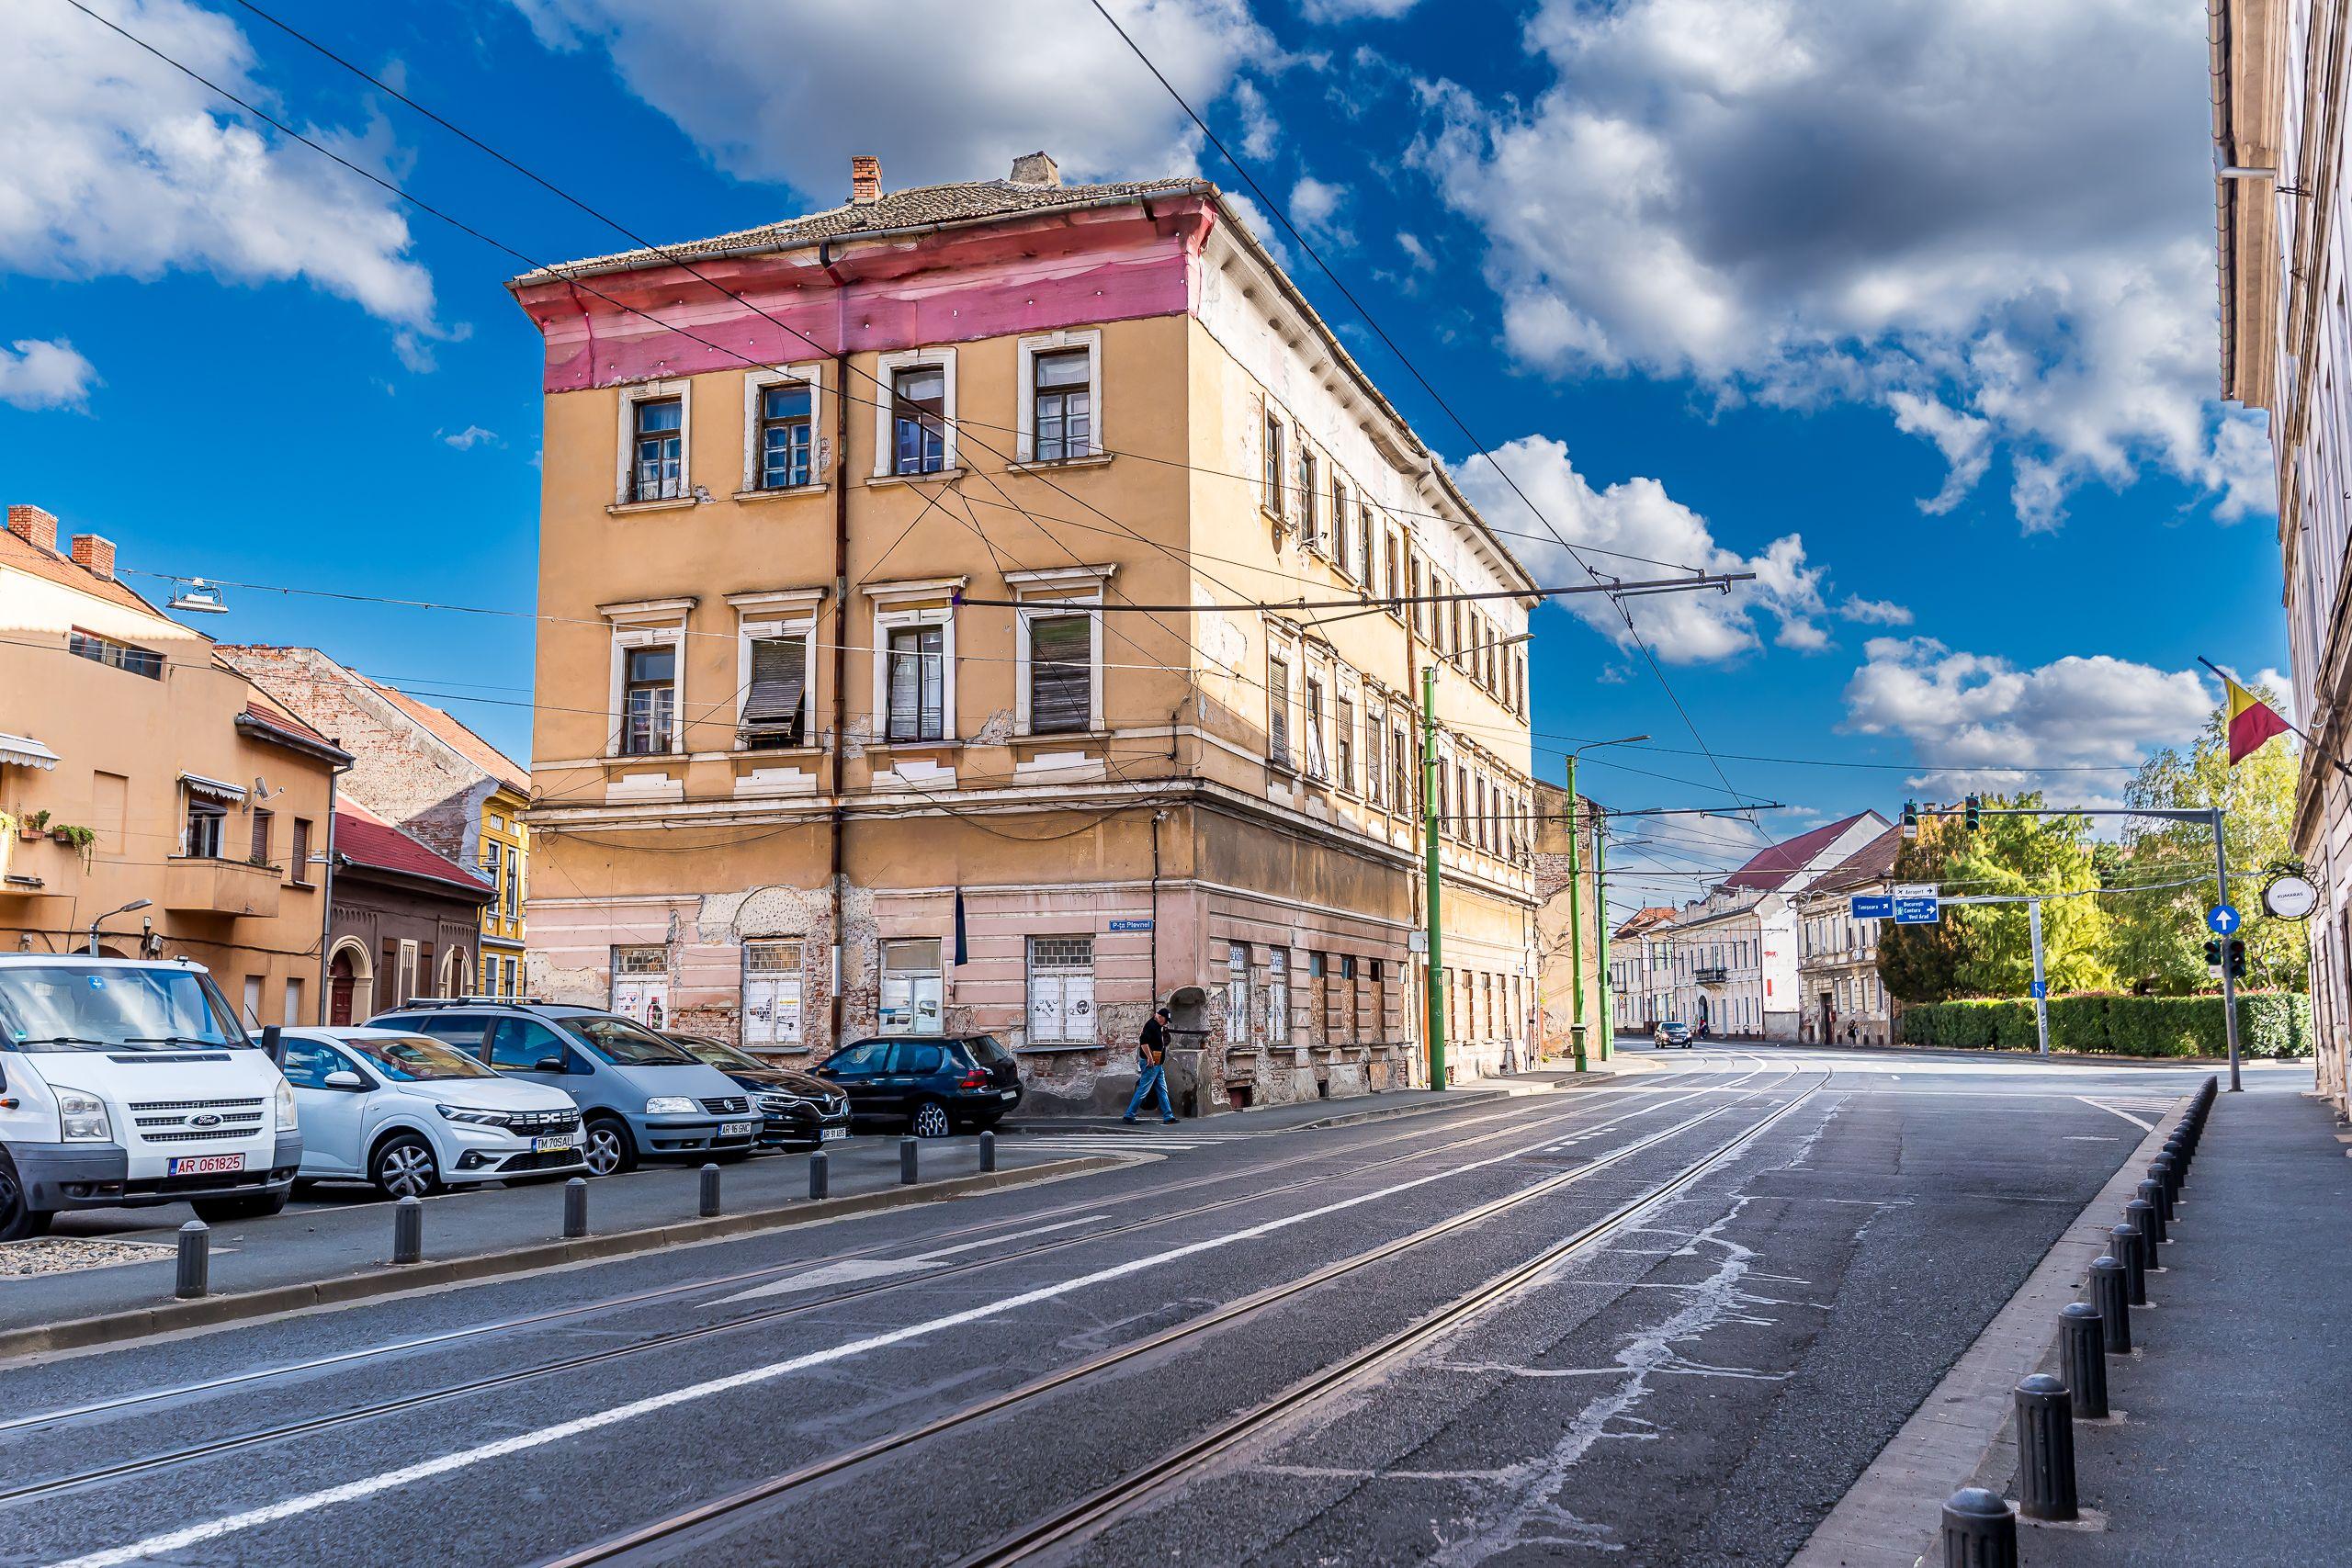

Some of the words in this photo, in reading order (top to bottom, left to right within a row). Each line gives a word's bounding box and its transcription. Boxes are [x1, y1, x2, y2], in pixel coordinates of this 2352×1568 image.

[198, 1115, 216, 1124] Ford
[721, 1124, 729, 1134] AR
[537, 1138, 548, 1149] TM
[178, 1159, 196, 1173] AR
[199, 1156, 241, 1171] 061825
